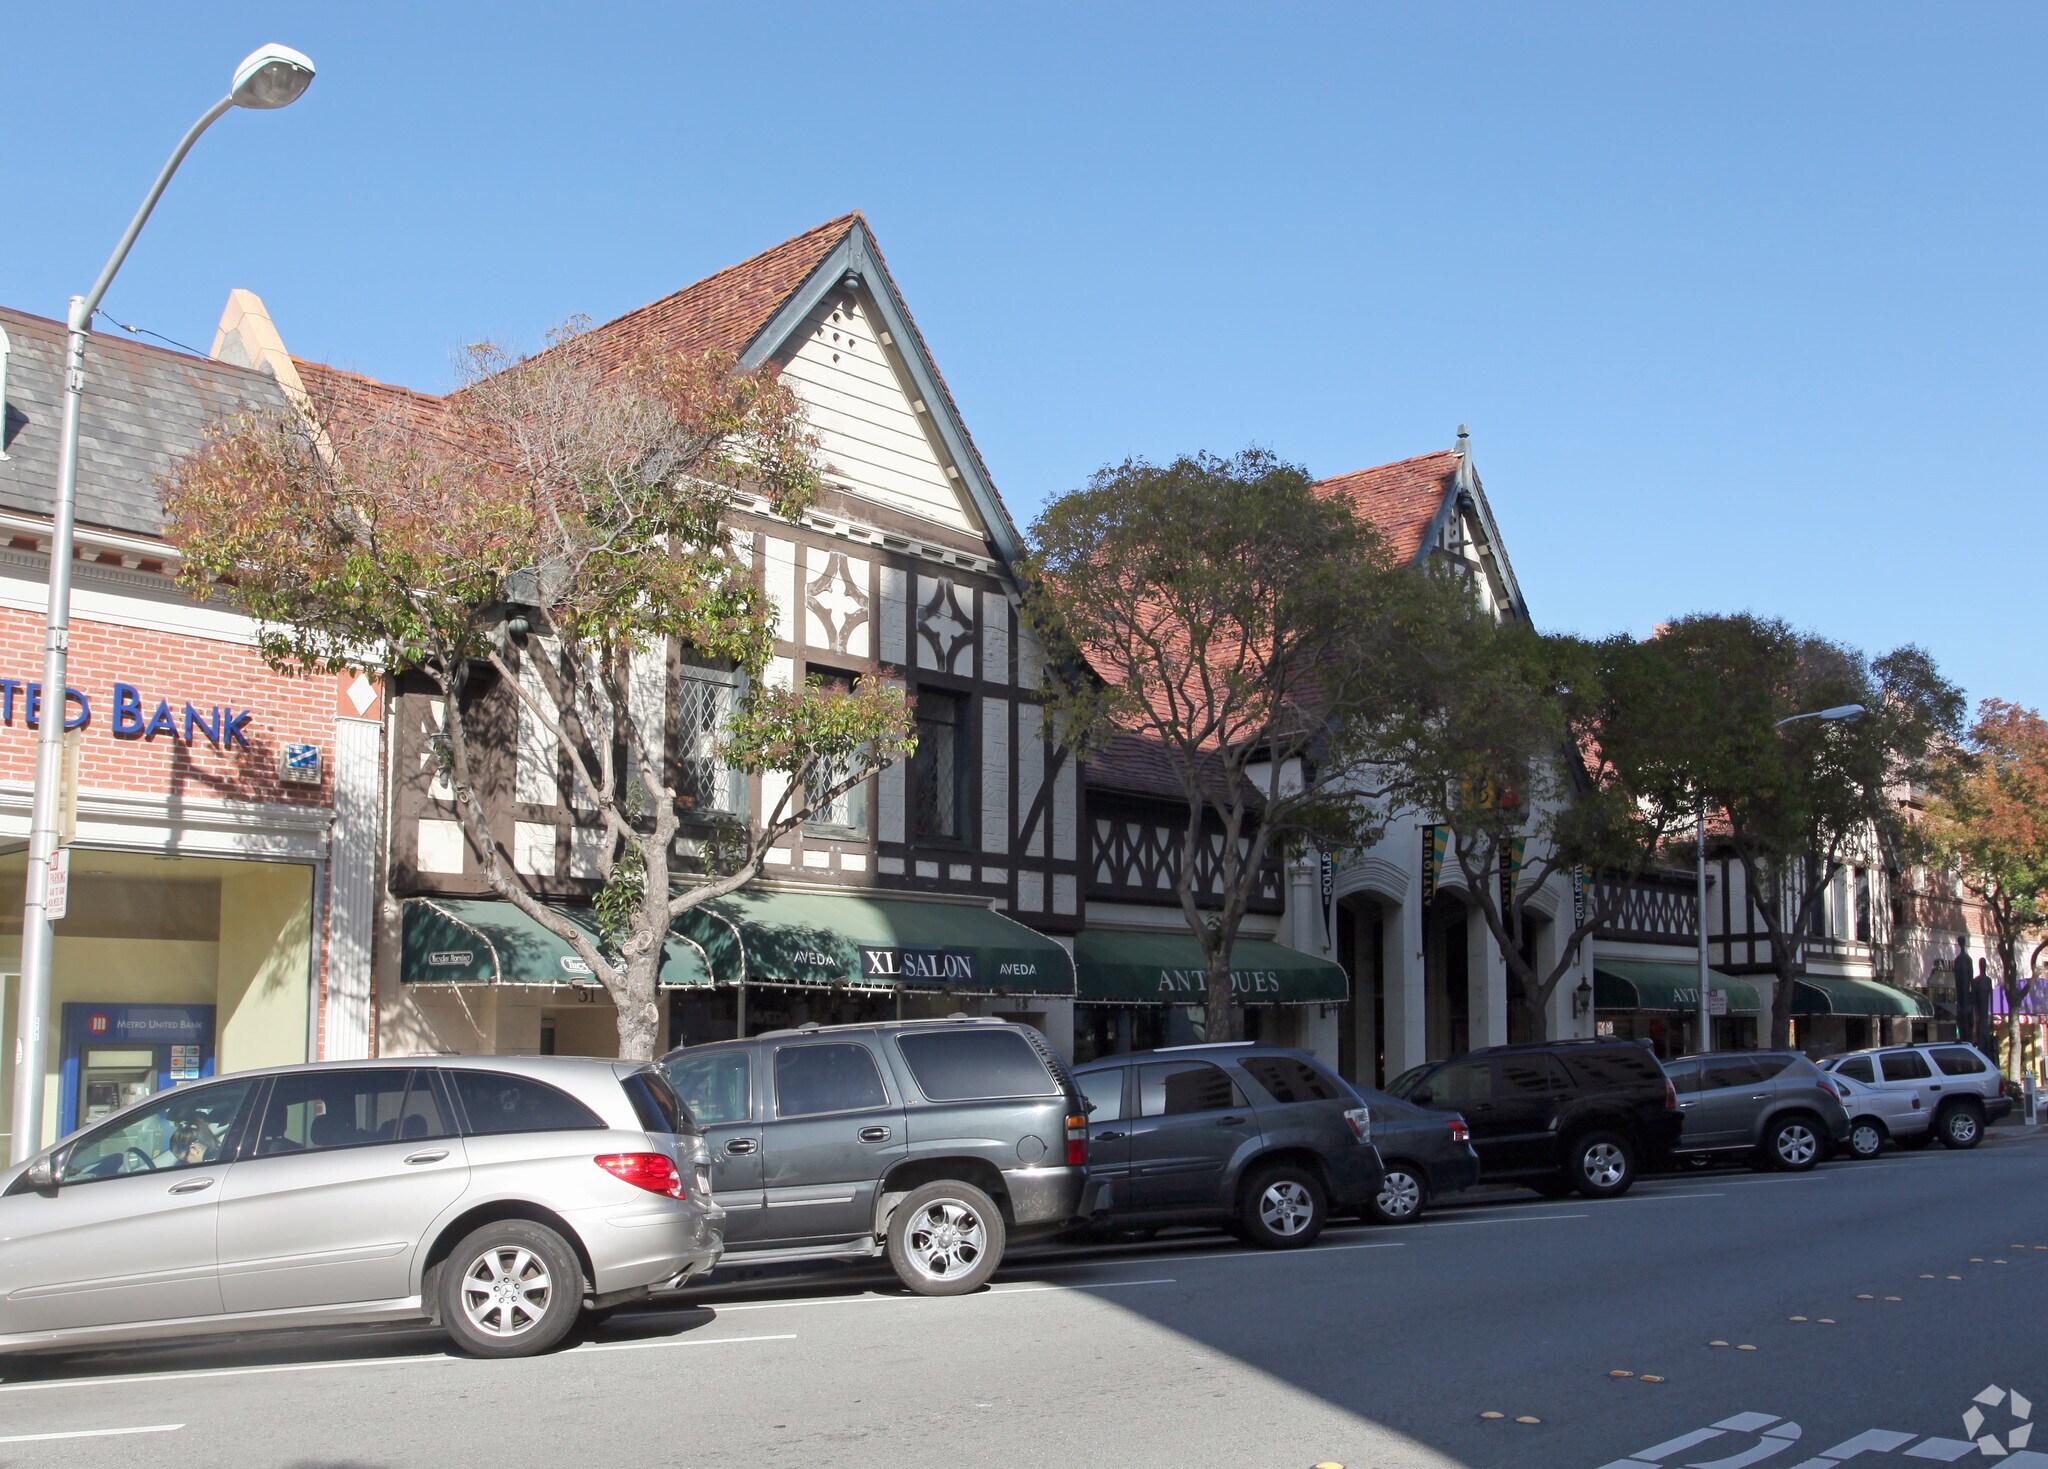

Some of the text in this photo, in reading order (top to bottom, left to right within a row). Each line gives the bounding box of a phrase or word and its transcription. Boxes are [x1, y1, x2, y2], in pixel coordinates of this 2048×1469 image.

[112, 682, 250, 747] BANK
[793, 950, 836, 967] AVEDA
[865, 950, 972, 979] XL SALON
[999, 963, 1037, 975] AVEDA
[1158, 970, 1279, 997] ANTUES
[578, 989, 597, 1003] 51
[117, 1020, 203, 1029] METRO UNITED BANK
